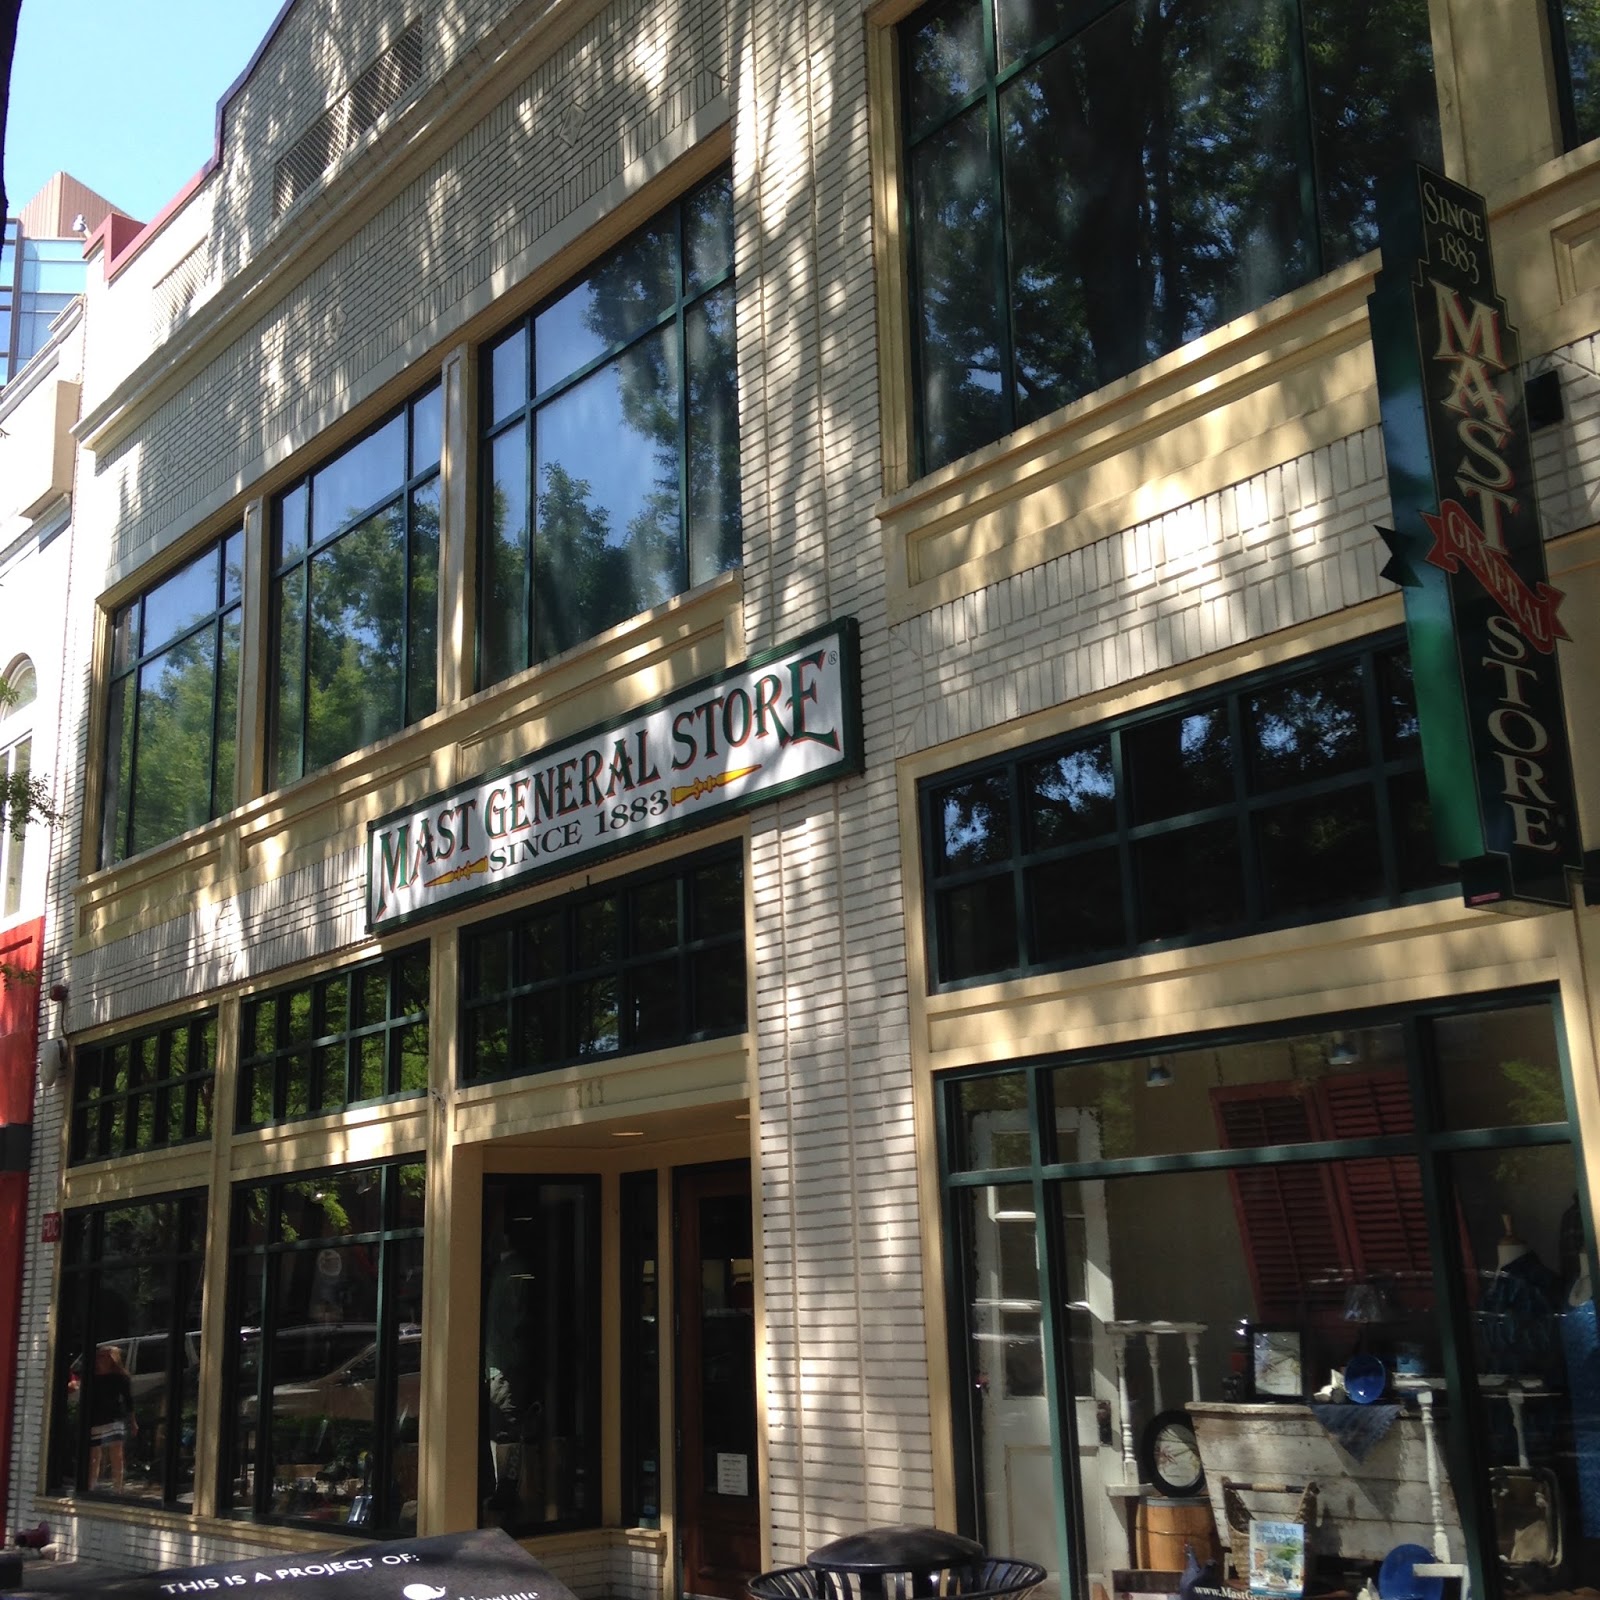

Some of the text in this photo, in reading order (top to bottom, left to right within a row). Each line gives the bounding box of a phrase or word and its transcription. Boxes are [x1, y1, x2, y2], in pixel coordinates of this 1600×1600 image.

[1423, 181, 1485, 243] SINCE
[1439, 232, 1481, 285] 1883
[1427, 277, 1520, 557] MAST
[1447, 511, 1549, 642] GENERAL
[376, 648, 841, 920] MAST GENERAL STORE
[1481, 615, 1560, 852] STORE
[489, 789, 669, 873] SINCE 1883
[160, 1552, 420, 1594] THIS IS A PROJECT OF:
